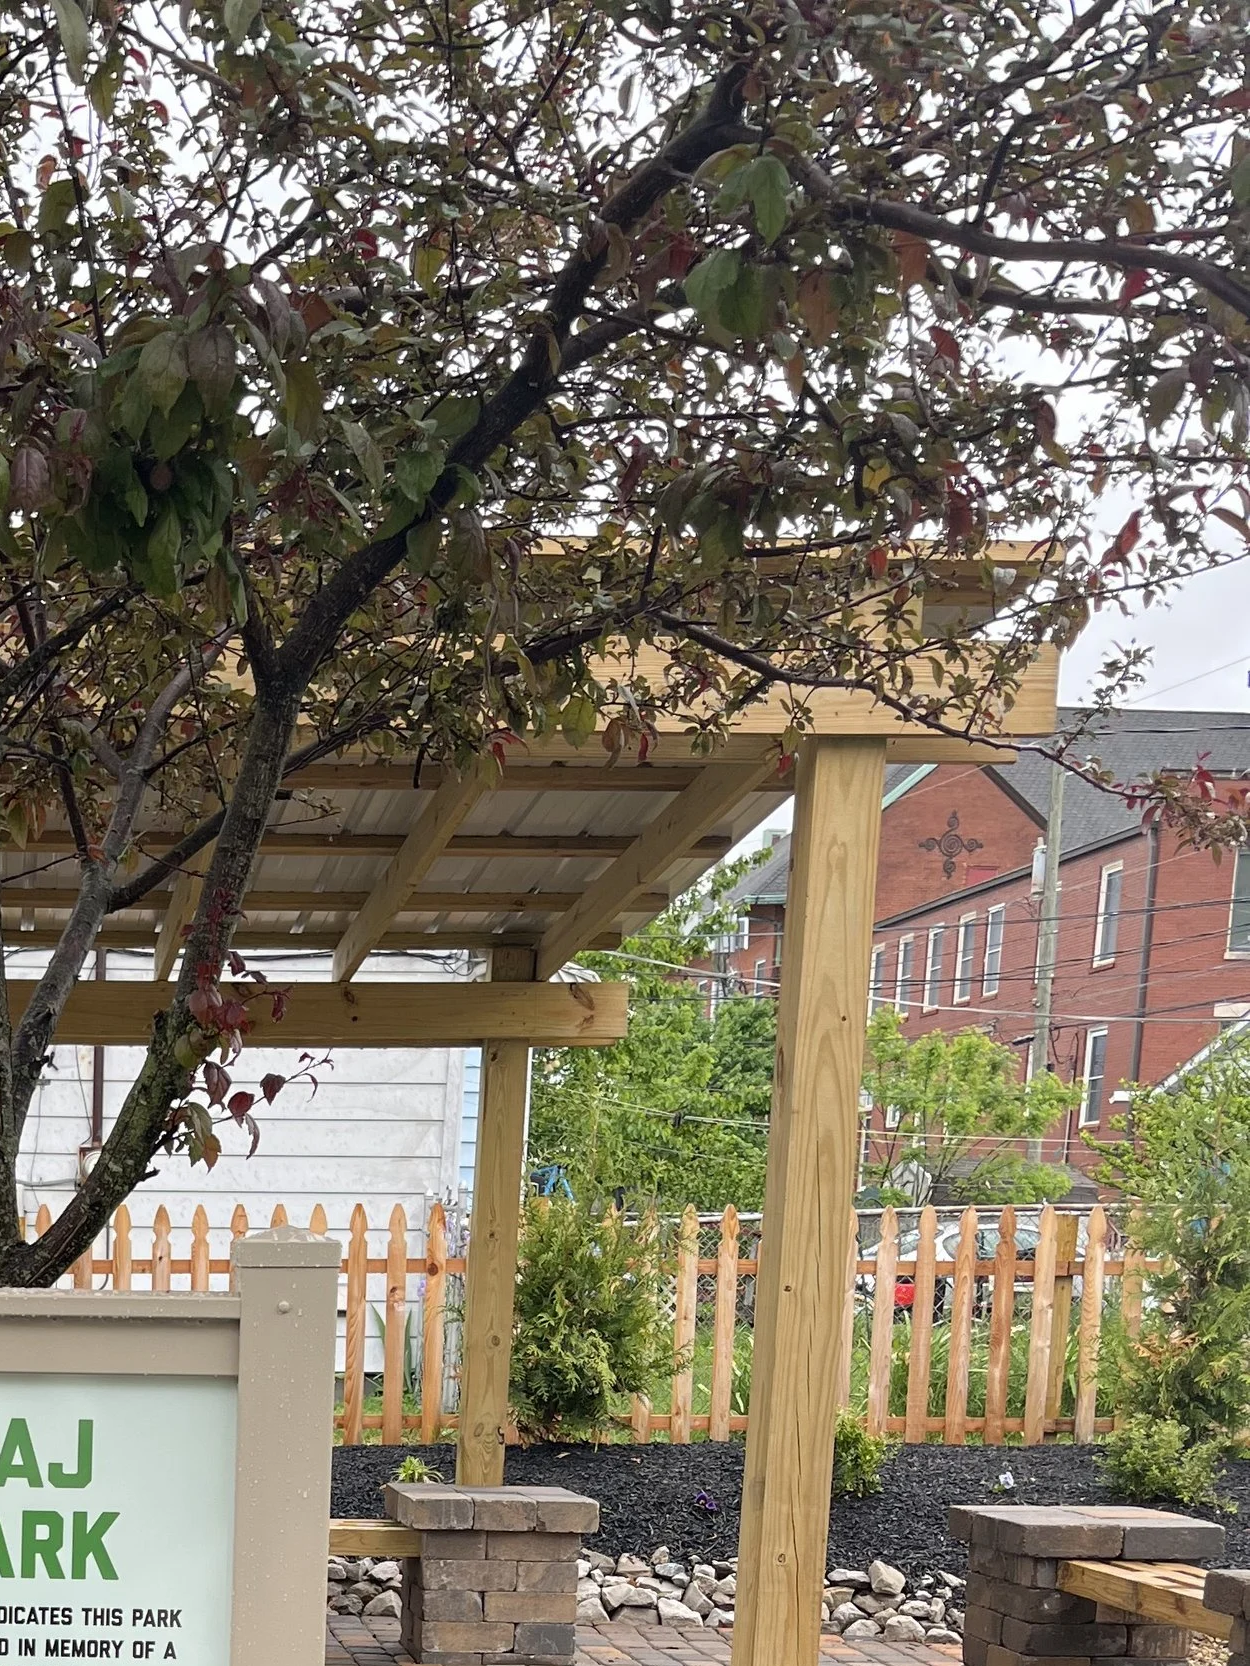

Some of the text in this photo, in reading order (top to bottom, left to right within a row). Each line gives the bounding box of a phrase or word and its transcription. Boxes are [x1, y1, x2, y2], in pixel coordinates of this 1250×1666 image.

[81, 1607, 124, 1627] THIS
[131, 1608, 183, 1629] PARK
[17, 1637, 37, 1657] IN
[44, 1638, 125, 1659] MEMORY
[132, 1640, 156, 1660] OF
[162, 1640, 177, 1660] A
